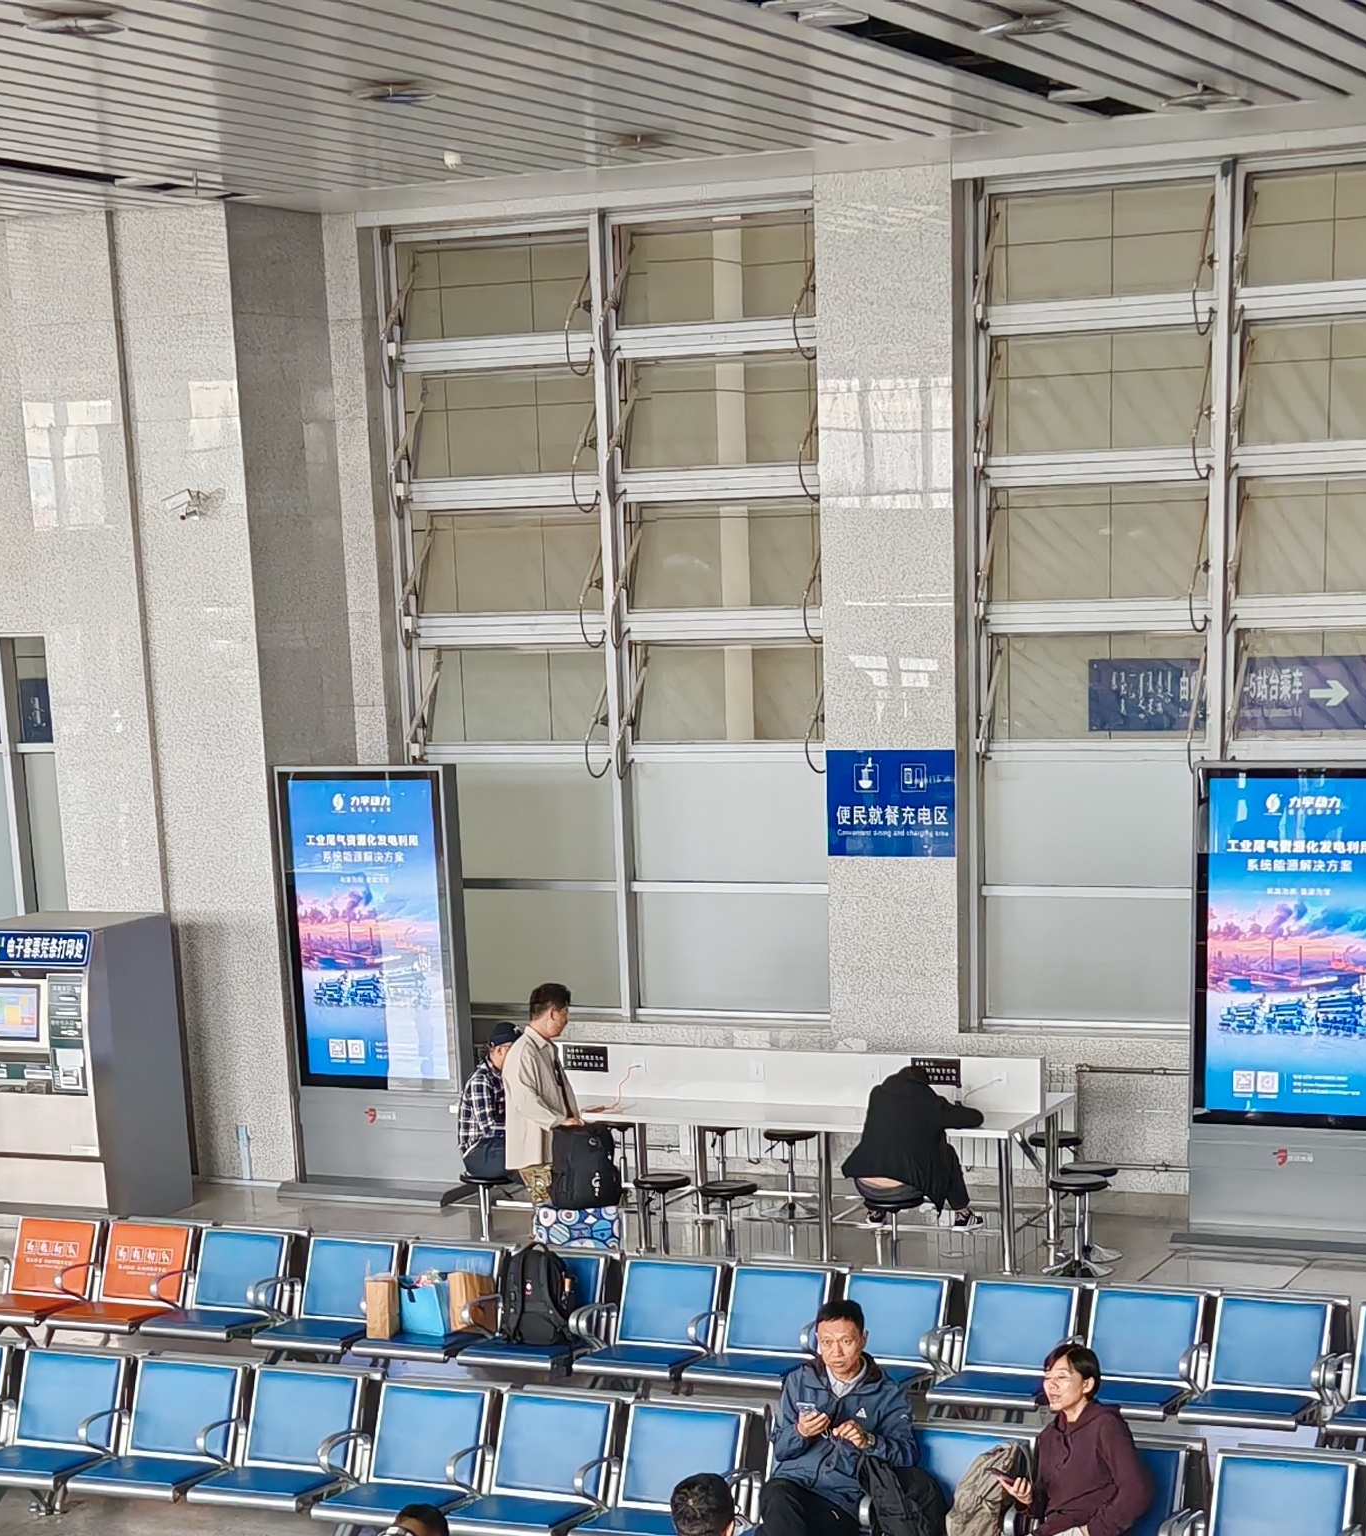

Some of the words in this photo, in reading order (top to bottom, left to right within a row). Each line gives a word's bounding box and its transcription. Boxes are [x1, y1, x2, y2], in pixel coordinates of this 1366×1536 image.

[837, 805, 949, 825] 便民就餐充电区
[6, 937, 84, 959] 电子客票凭条打印处
